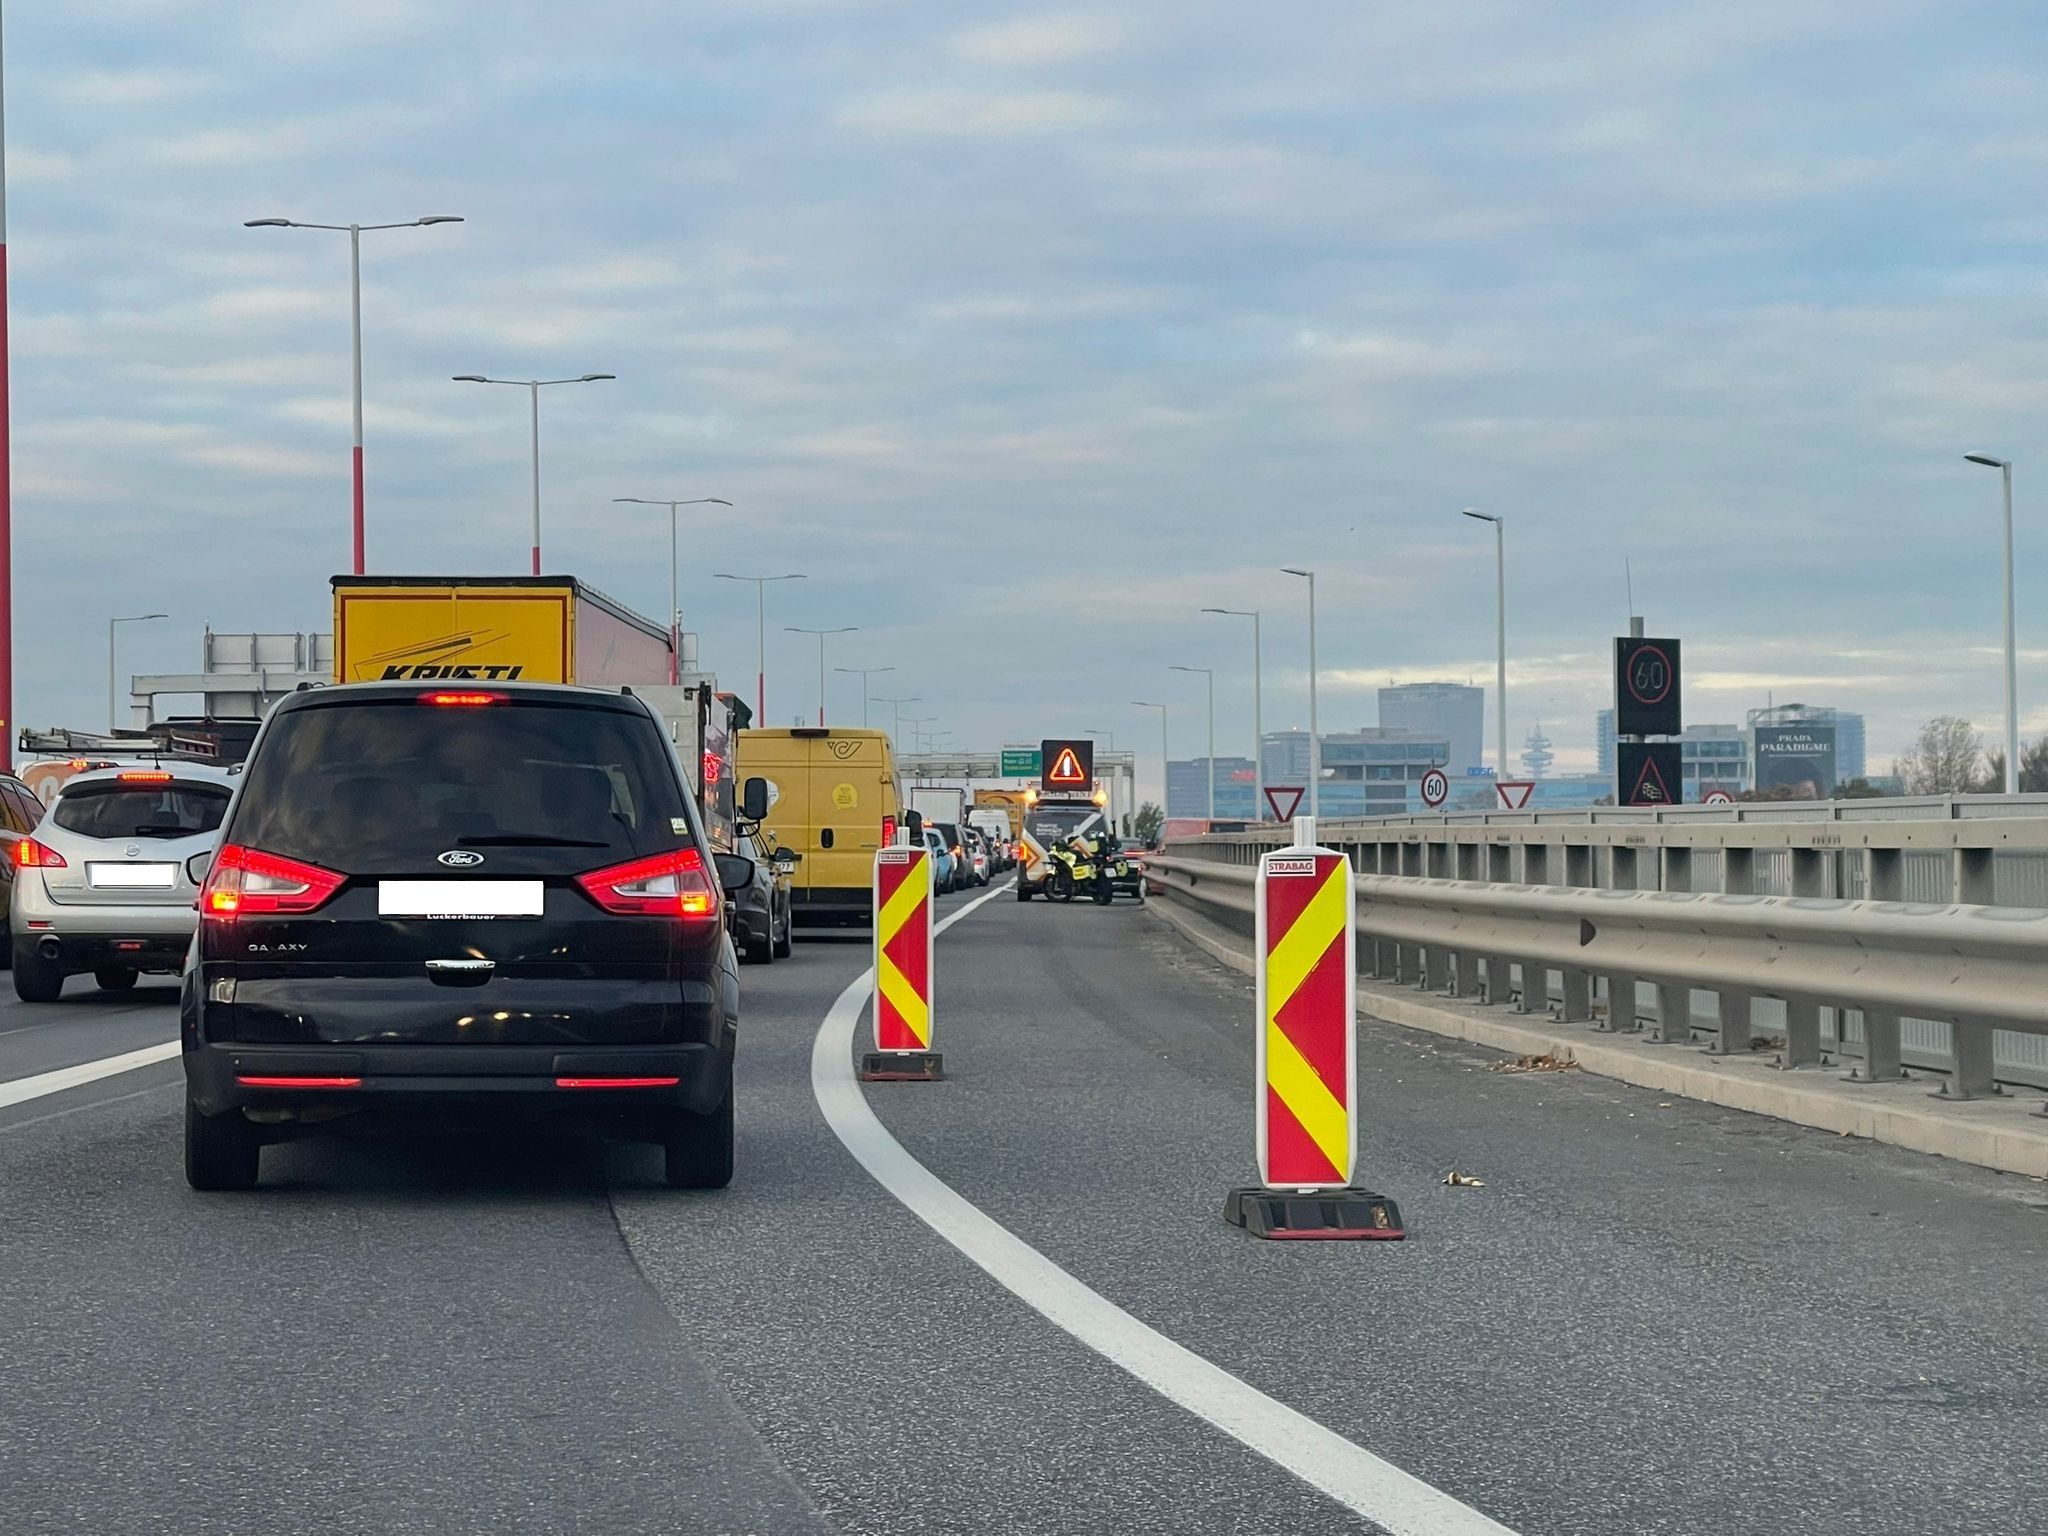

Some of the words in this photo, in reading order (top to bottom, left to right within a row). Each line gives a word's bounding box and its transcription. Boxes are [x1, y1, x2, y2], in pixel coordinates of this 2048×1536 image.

[1636, 662, 1663, 689] 60
[1761, 743, 1831, 752] PARADIGME
[1427, 779, 1441, 796] 60
[1268, 862, 1313, 871] STRABAG
